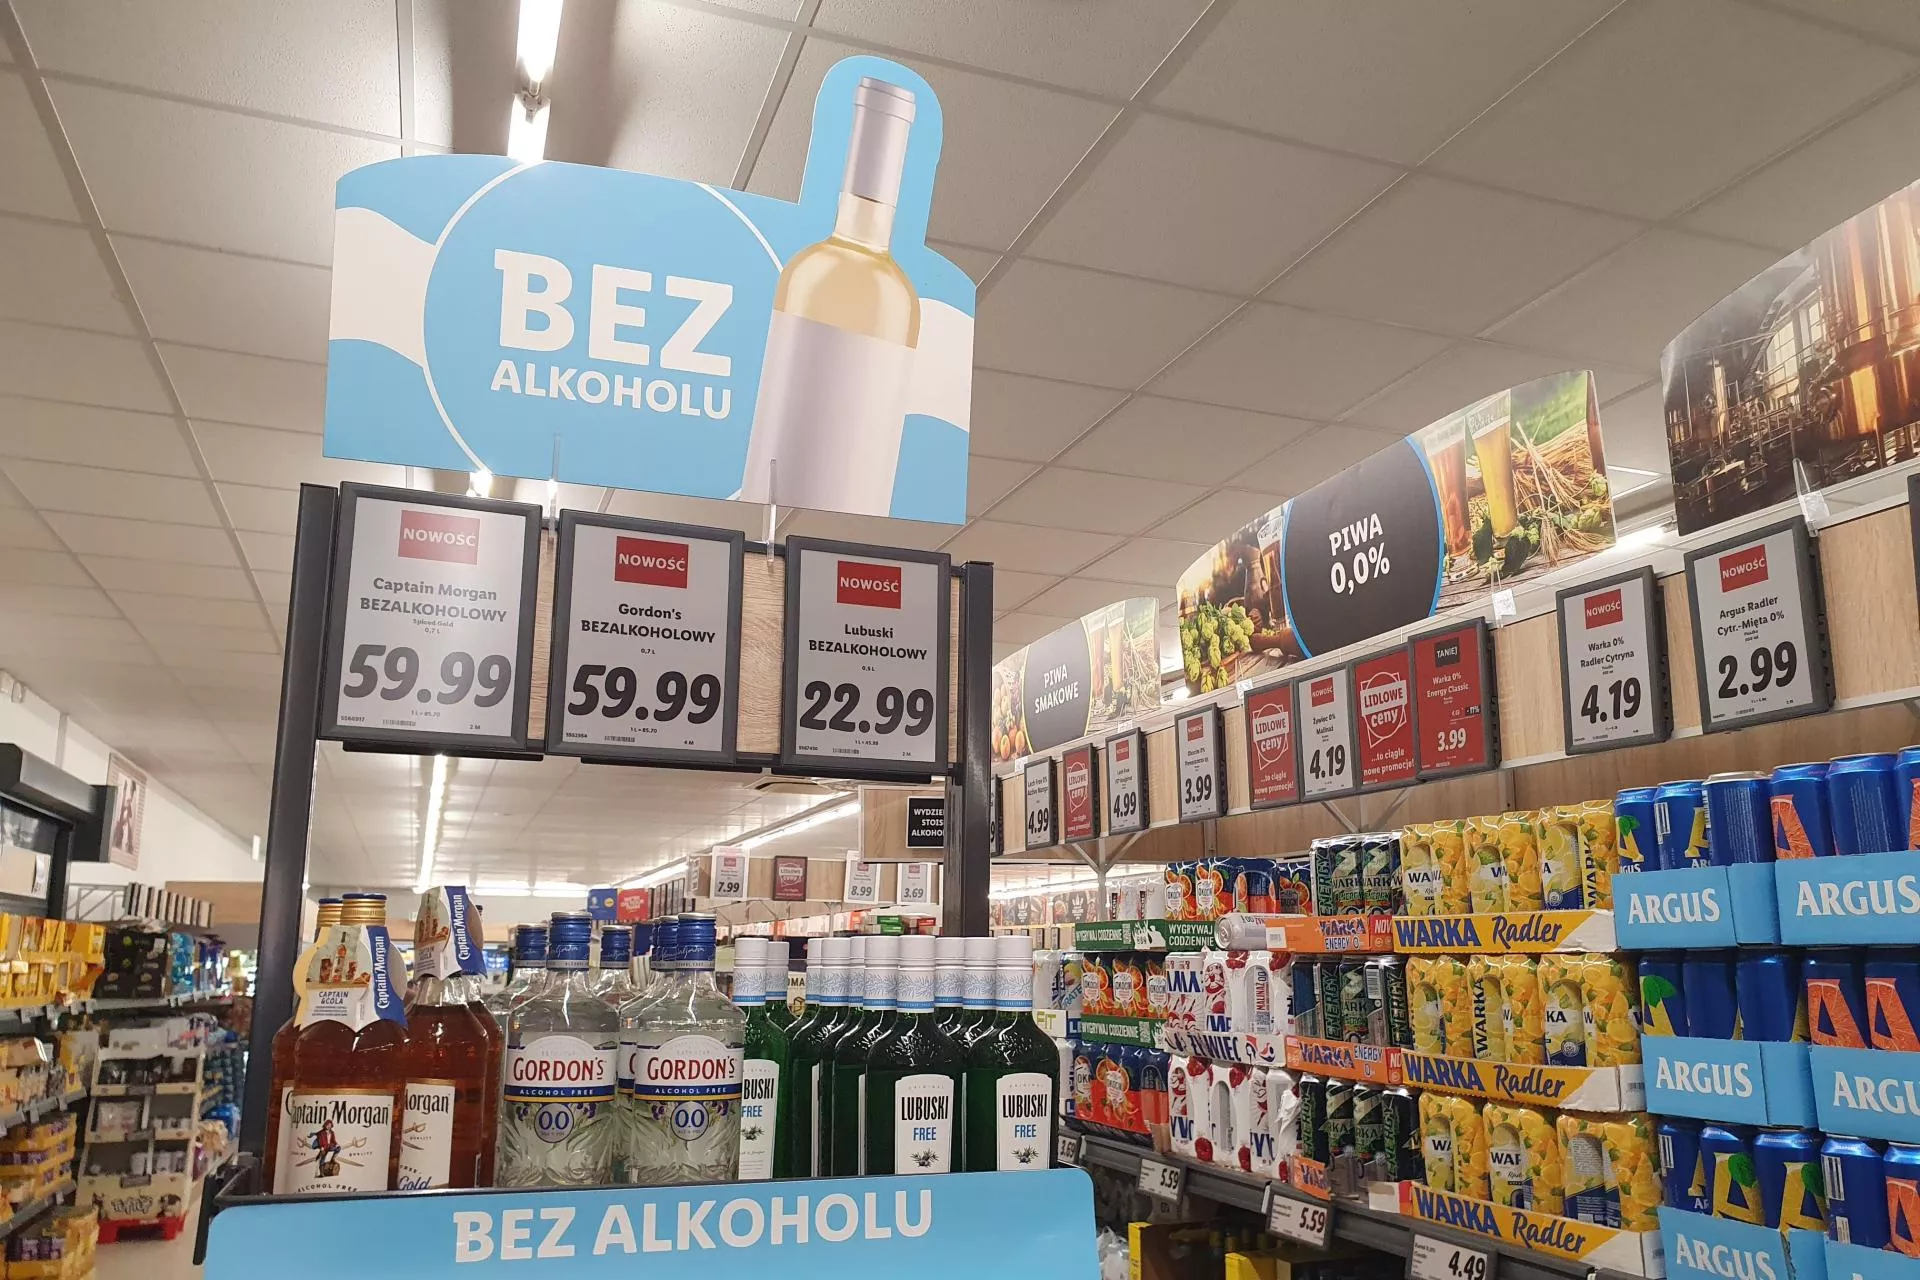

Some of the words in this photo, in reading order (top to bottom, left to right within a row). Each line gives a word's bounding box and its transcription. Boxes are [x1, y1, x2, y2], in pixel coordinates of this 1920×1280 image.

[494, 248, 734, 377] BEZ
[490, 359, 733, 420] ALKOHOLU
[402, 526, 477, 548] NOWOŚĆ
[1328, 513, 1383, 557] PIWA
[619, 552, 686, 572] NOWOŚĆ
[1330, 542, 1390, 595] 0,0%
[1721, 557, 1766, 579] NOWOŚĆ
[373, 577, 434, 600] Captain
[438, 583, 497, 602] Morgan
[840, 576, 899, 594] NOWOŚĆ
[360, 597, 507, 623] BEZALKOHOLOWY
[618, 603, 682, 620] Gordon's
[1586, 599, 1621, 617] NOWOŚĆ
[1719, 606, 1746, 620] Argus
[1748, 596, 1779, 611] Radler
[581, 619, 716, 643] BEZALKOHOLOWY
[844, 623, 894, 639] Lubuski
[1717, 616, 1768, 636] Cytr.-Mięta
[1770, 610, 1785, 623] 0%
[808, 639, 928, 661] BEZALKOHOLOWY
[1437, 646, 1458, 659] TANIEJ
[1588, 640, 1611, 652] Warka
[1613, 636, 1625, 646] 0%
[1580, 656, 1604, 668] Radler
[1605, 650, 1635, 664] Cytryna
[1718, 641, 1798, 699] 2.99
[343, 644, 512, 708] 59.99
[1043, 664, 1068, 688] PIWA
[1432, 674, 1451, 685] Warka
[1452, 672, 1462, 681] 0%
[567, 664, 722, 725] 59.99
[1034, 681, 1079, 714] SMAKOWE
[1364, 687, 1403, 708] LIDLOWE
[1427, 686, 1447, 698] Energy
[1448, 682, 1469, 693] Classic
[1581, 677, 1641, 724] 4.19
[799, 680, 935, 737] 22.99
[1371, 708, 1398, 728] ceny
[1255, 718, 1286, 735] LIDLOWE
[1261, 736, 1282, 752] ceny
[1437, 727, 1466, 752] 3.99
[1310, 744, 1346, 779] 4.19
[1384, 747, 1405, 761] ciągle
[1363, 766, 1381, 777] nowe
[1381, 758, 1415, 776] promocje!
[1185, 774, 1212, 804] 3.99
[914, 808, 944, 816] WYDZIE
[1113, 791, 1137, 818] 4.99
[1029, 807, 1049, 834] 4.99
[911, 829, 944, 837] ALKOHO
[718, 882, 740, 893] 7.99
[851, 885, 872, 896] 8.99
[904, 888, 924, 898] 3.69
[1317, 852, 1334, 915] ENERGY
[1628, 887, 1721, 925] ARGUS
[1796, 875, 1920, 917] ARGUS
[1076, 930, 1098, 941] WYGRYWAJ
[1098, 929, 1122, 941] CODZIENNIE
[1168, 925, 1213, 935] WYGRYWAJ
[1319, 919, 1367, 936] WARKA
[1395, 918, 1482, 948] WARKA
[1492, 914, 1562, 950] Radler
[1168, 936, 1215, 946] CODZIENNIE
[1325, 937, 1350, 950] ENERGY
[373, 936, 387, 976] Morgan
[375, 975, 390, 1009] Captain
[788, 977, 805, 987] MA
[1473, 977, 1488, 1053] WARKA
[1081, 1022, 1109, 1035] WYGRYWAJ
[1109, 1024, 1139, 1039] CODZIENNIE
[1299, 1042, 1355, 1069] WARKA
[1354, 1046, 1383, 1062] ENERGY
[514, 1057, 604, 1081] GORDON'S
[647, 1056, 736, 1080] GORDON'S
[1404, 1052, 1485, 1092] WARKA
[1493, 1064, 1566, 1098] Radler
[1656, 1056, 1753, 1098] ARGUS
[285, 1090, 328, 1128] Captain
[329, 1100, 389, 1128] Morgan
[741, 1105, 763, 1118] FREE
[901, 1096, 949, 1121] LUBUSKI
[1002, 1094, 1048, 1118] LUBUSKI
[539, 1111, 570, 1130] 0.0
[675, 1109, 705, 1129] 0.0
[1014, 1124, 1037, 1138] FREE
[913, 1127, 937, 1141] FREE
[400, 1176, 432, 1191] Gold
[1160, 1168, 1179, 1190] 5.59
[452, 1206, 576, 1263] BEZ
[593, 1189, 933, 1256] ALKOHOLU
[1299, 1207, 1327, 1233] 5.59
[1412, 1187, 1503, 1237] WARKA
[1512, 1212, 1586, 1253] Radler
[1448, 1250, 1486, 1280] 4.49
[1676, 1233, 1778, 1280] ARGUS
